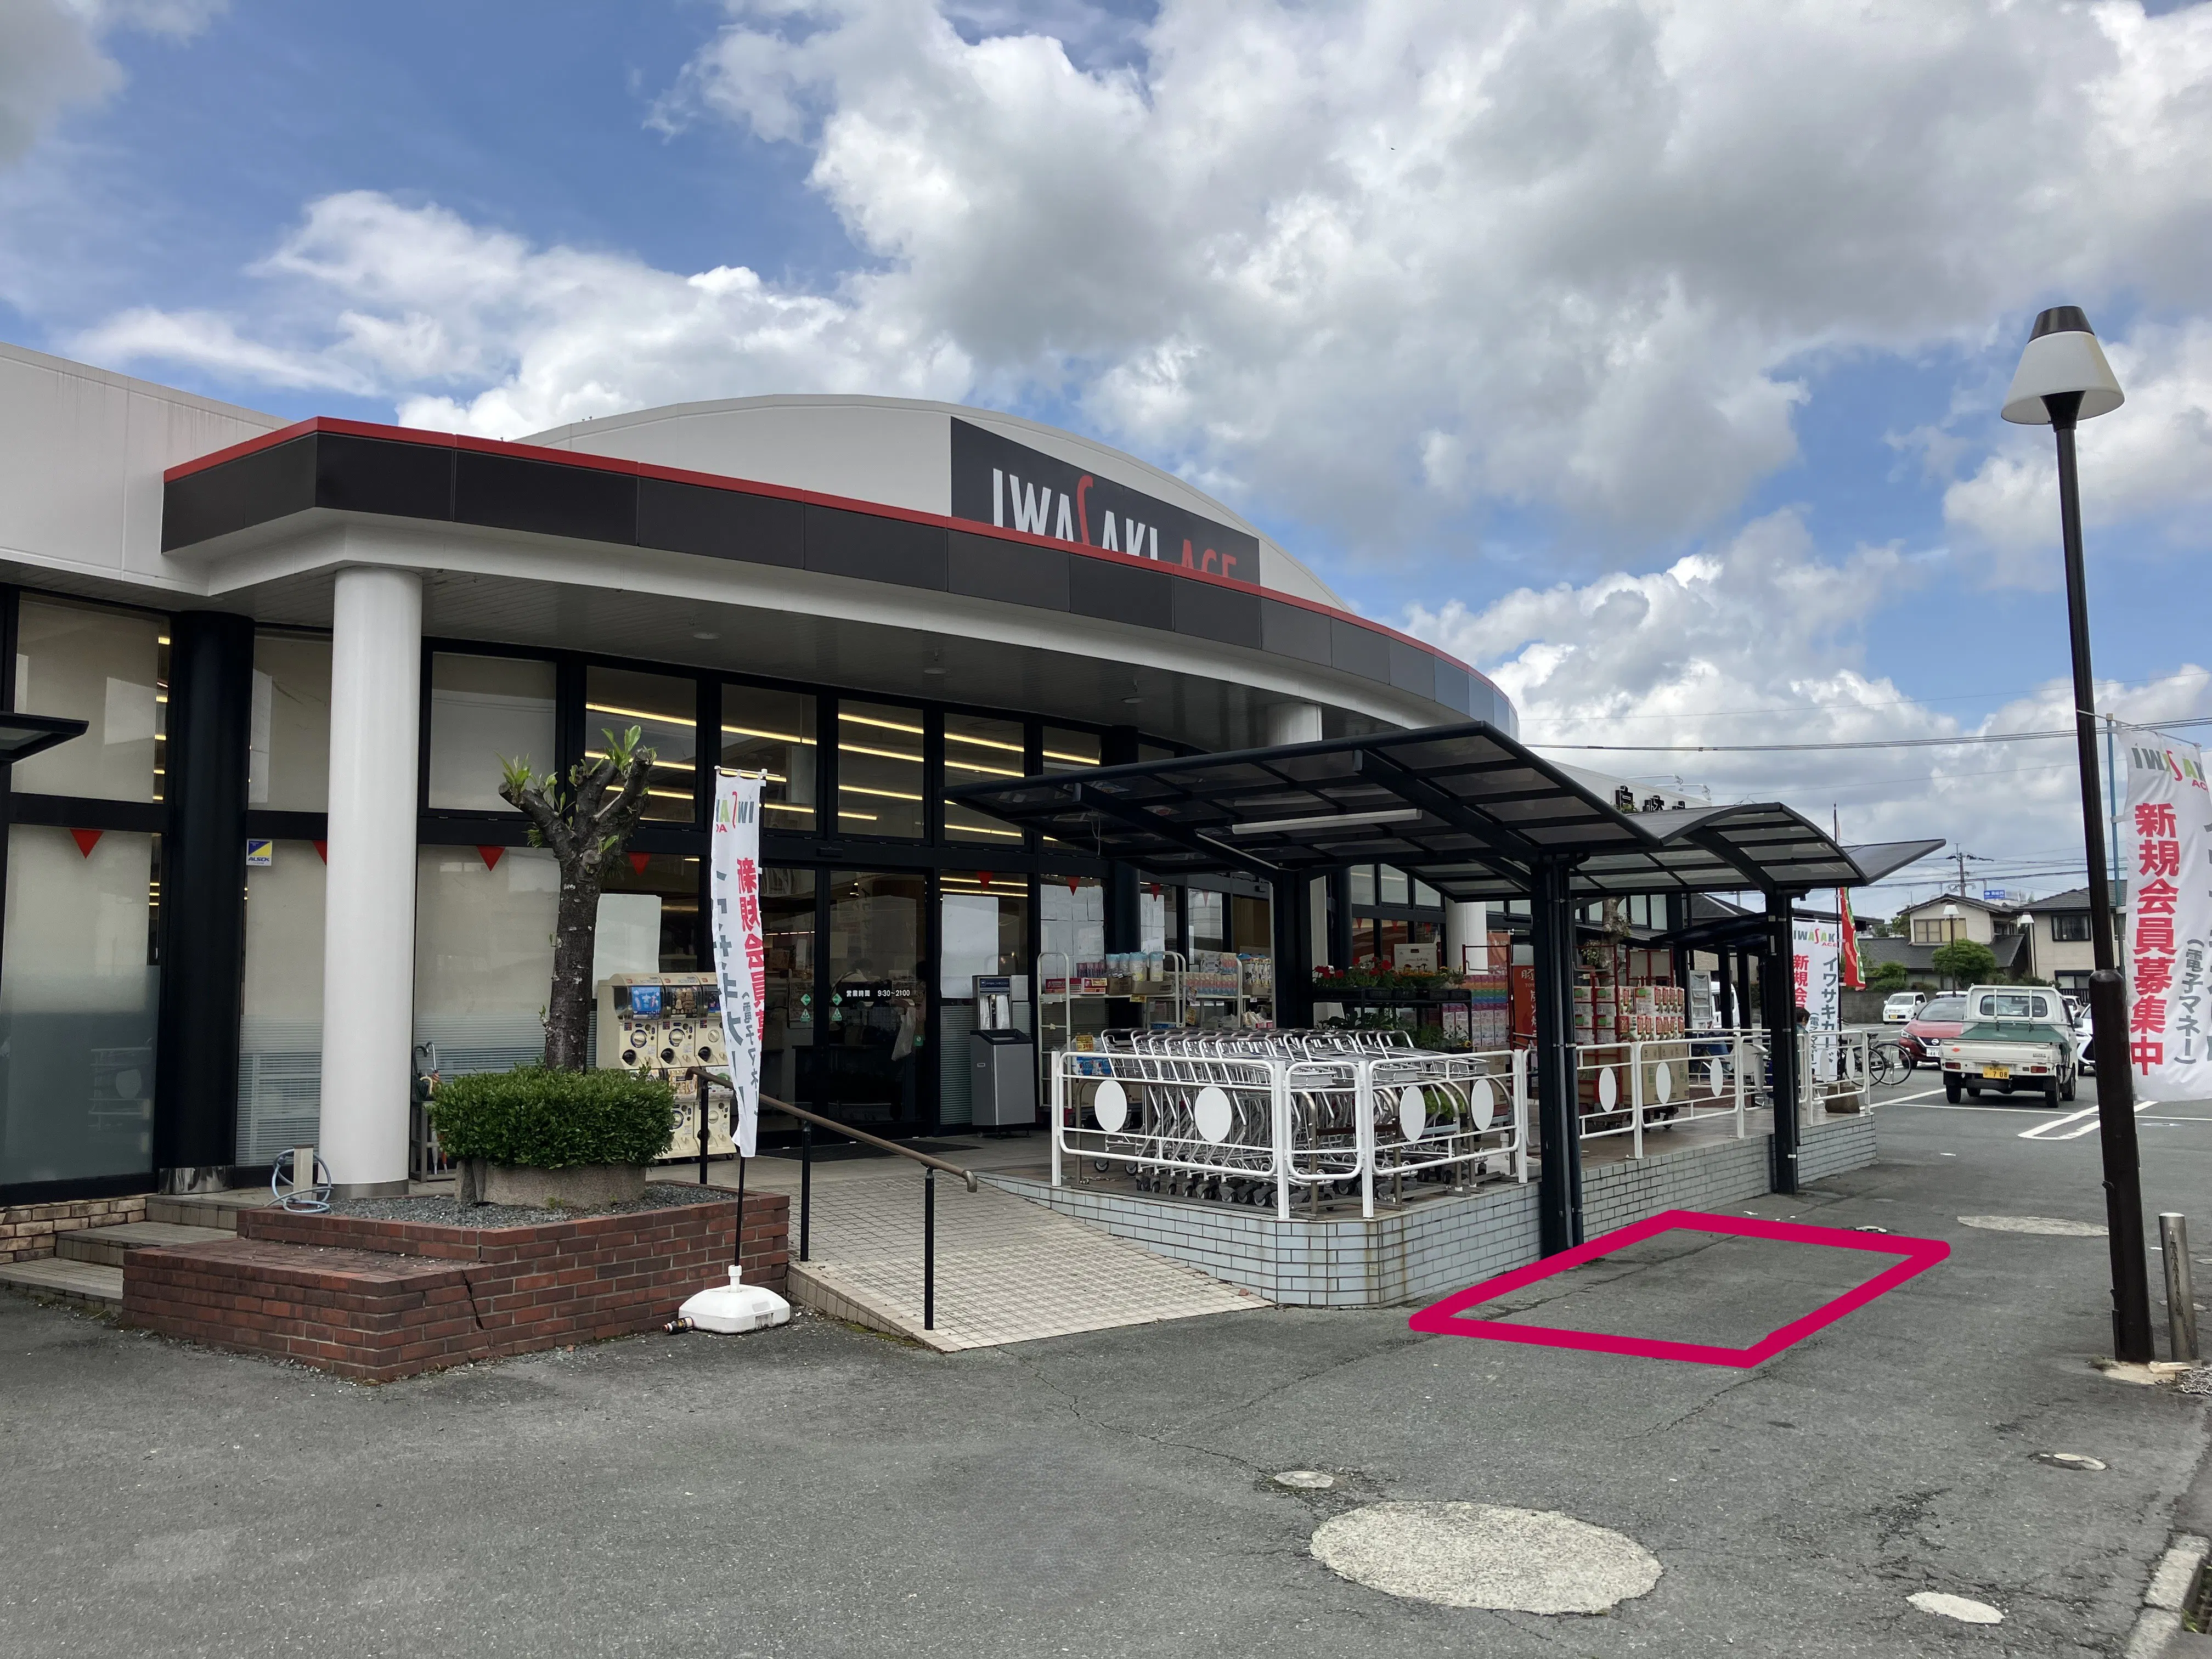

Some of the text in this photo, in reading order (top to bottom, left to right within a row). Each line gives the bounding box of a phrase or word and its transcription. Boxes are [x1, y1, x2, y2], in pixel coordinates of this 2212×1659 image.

[1793, 928, 1836, 944] IWASAK
[2130, 803, 2180, 1076] 新規会員募集中
